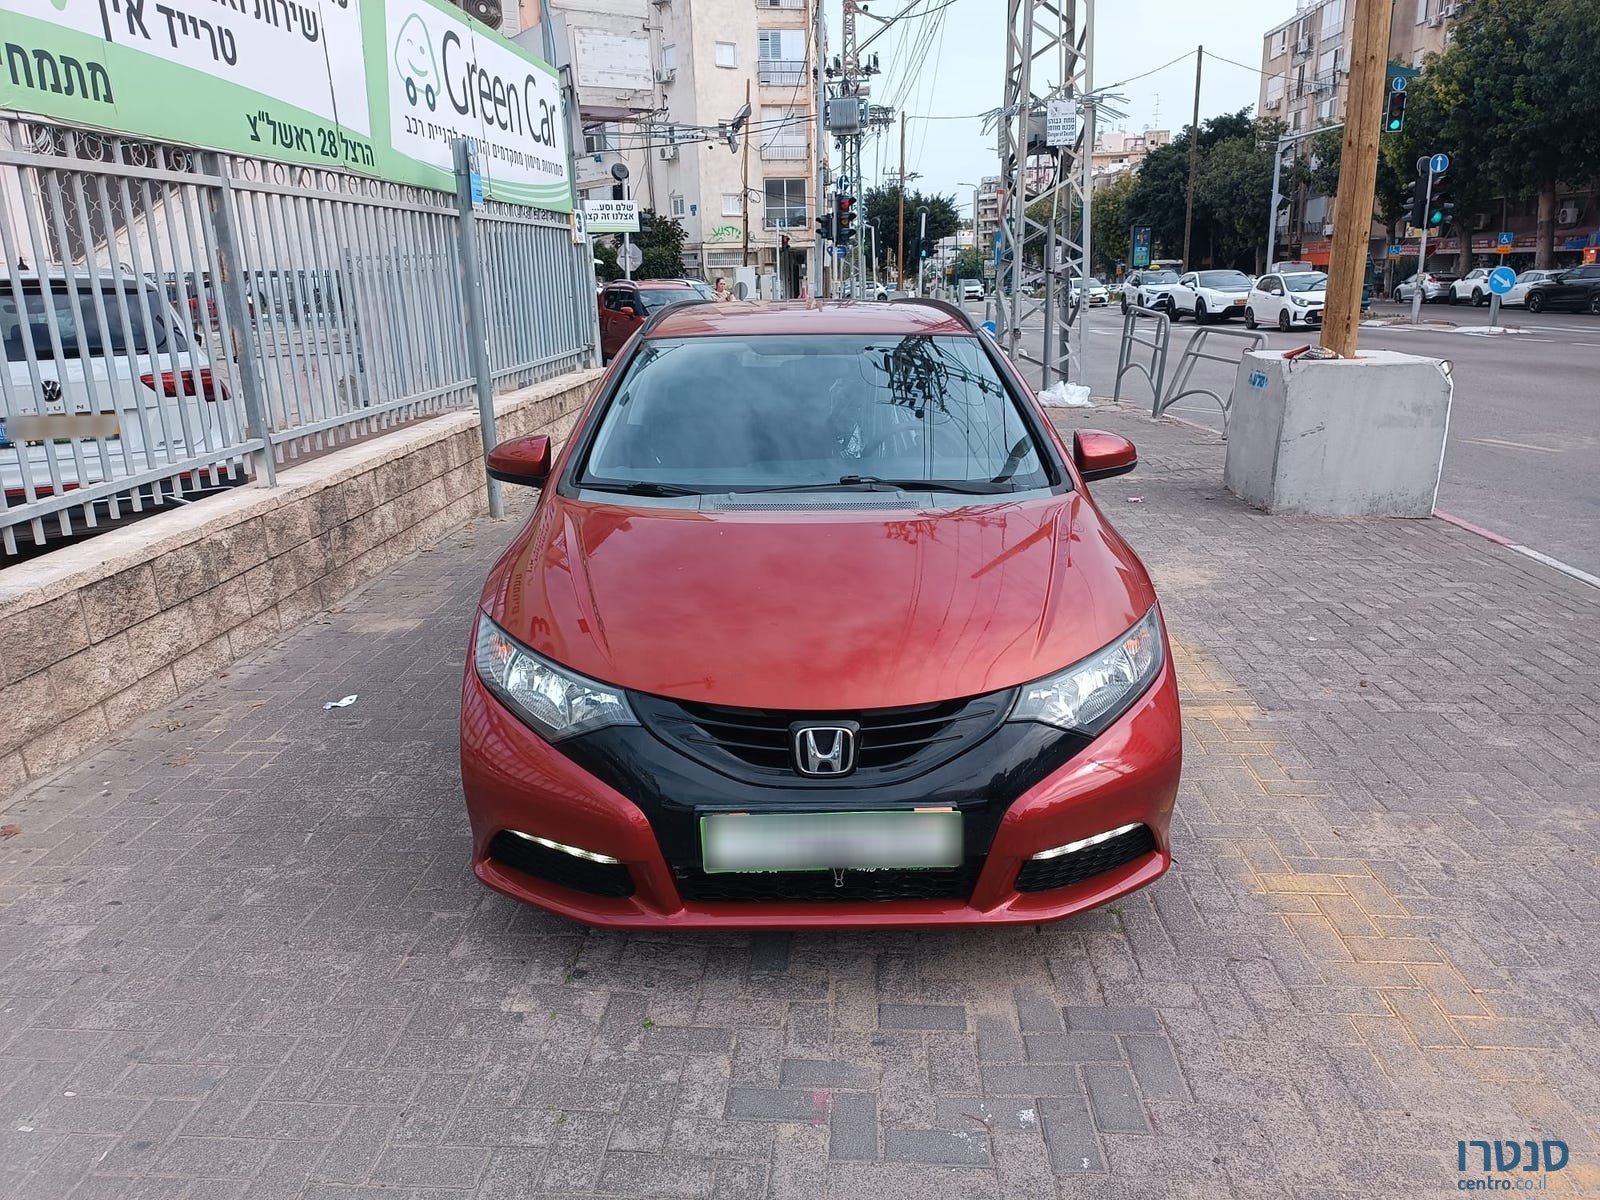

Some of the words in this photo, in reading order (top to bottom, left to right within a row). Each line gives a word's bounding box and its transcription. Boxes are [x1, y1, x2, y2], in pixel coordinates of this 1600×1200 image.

[99, 0, 151, 42] אין
[156, 3, 237, 66] טרייד
[442, 30, 522, 136] Green
[524, 74, 556, 149] Car
[317, 127, 338, 158] 28
[404, 115, 425, 137] רכב
[340, 131, 375, 166] הרצל
[612, 212, 634, 220] אצלנו
[615, 203, 634, 211] שלם
